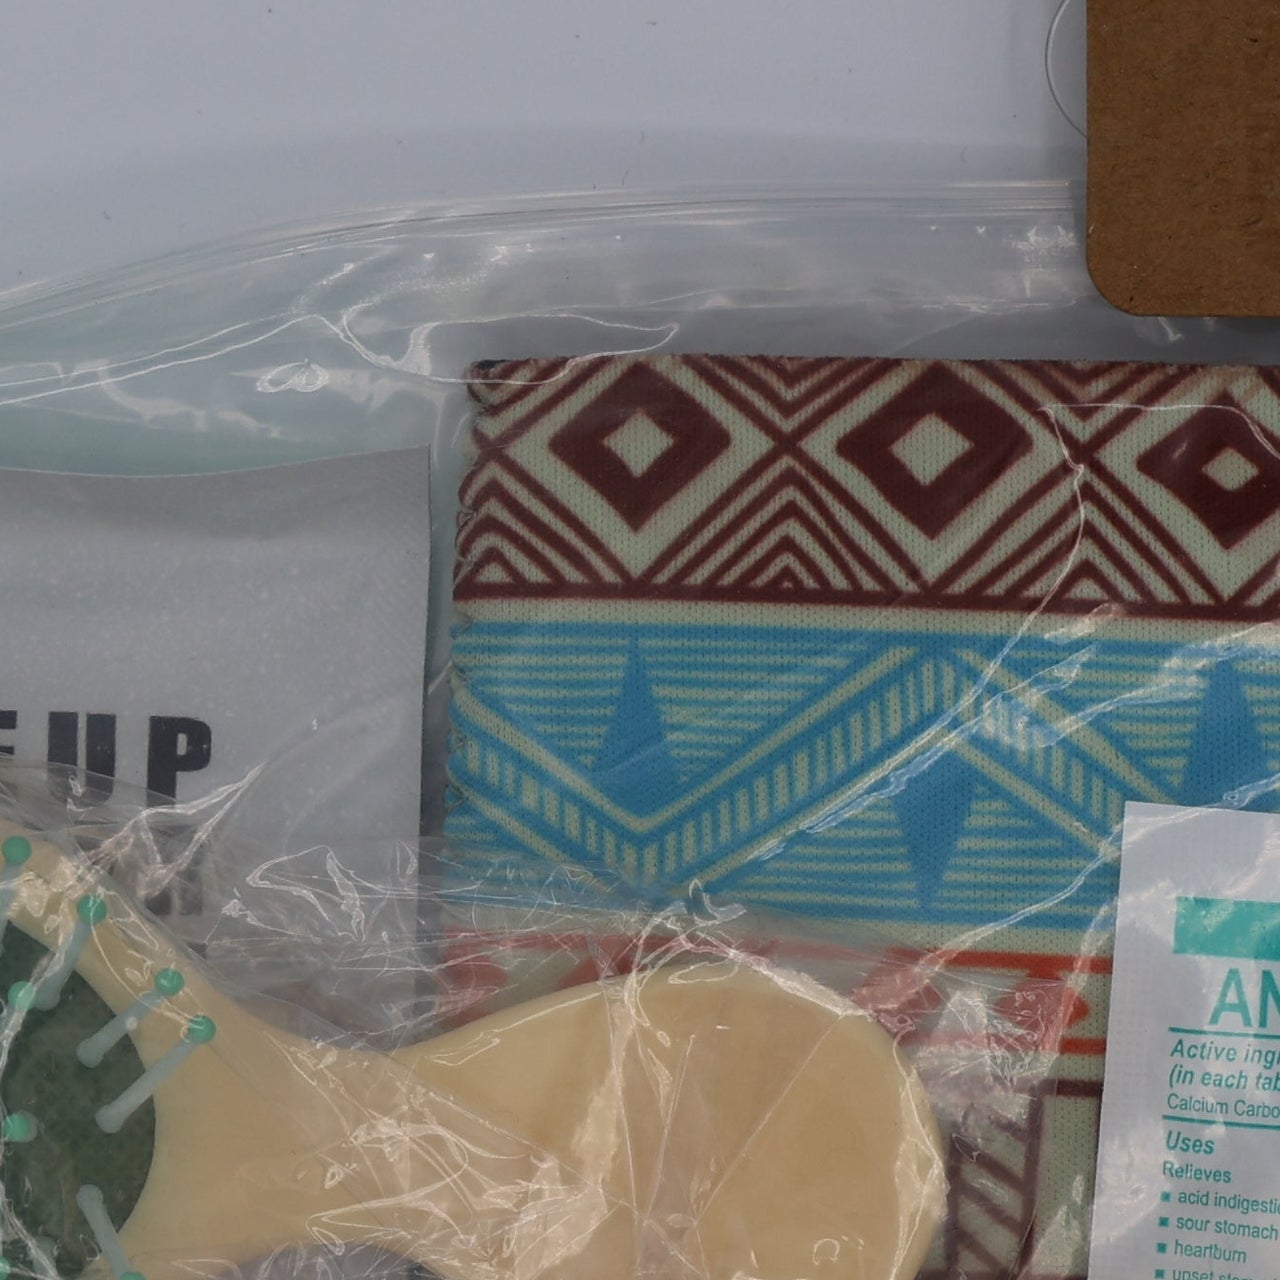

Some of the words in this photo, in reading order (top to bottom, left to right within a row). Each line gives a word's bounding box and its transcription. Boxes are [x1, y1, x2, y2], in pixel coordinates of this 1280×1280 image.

[1170, 1039, 1237, 1062] Active
[1170, 1064, 1193, 1088] (in
[1201, 1070, 1248, 1090] each
[1167, 1093, 1229, 1114] Calcium
[1166, 1130, 1215, 1155] Uses
[1162, 1160, 1231, 1184] Relieves
[1178, 1190, 1209, 1206] acid
[1176, 1217, 1210, 1232] sour
[1215, 1220, 1279, 1240] stomach
[1174, 1240, 1247, 1263] heartburn
